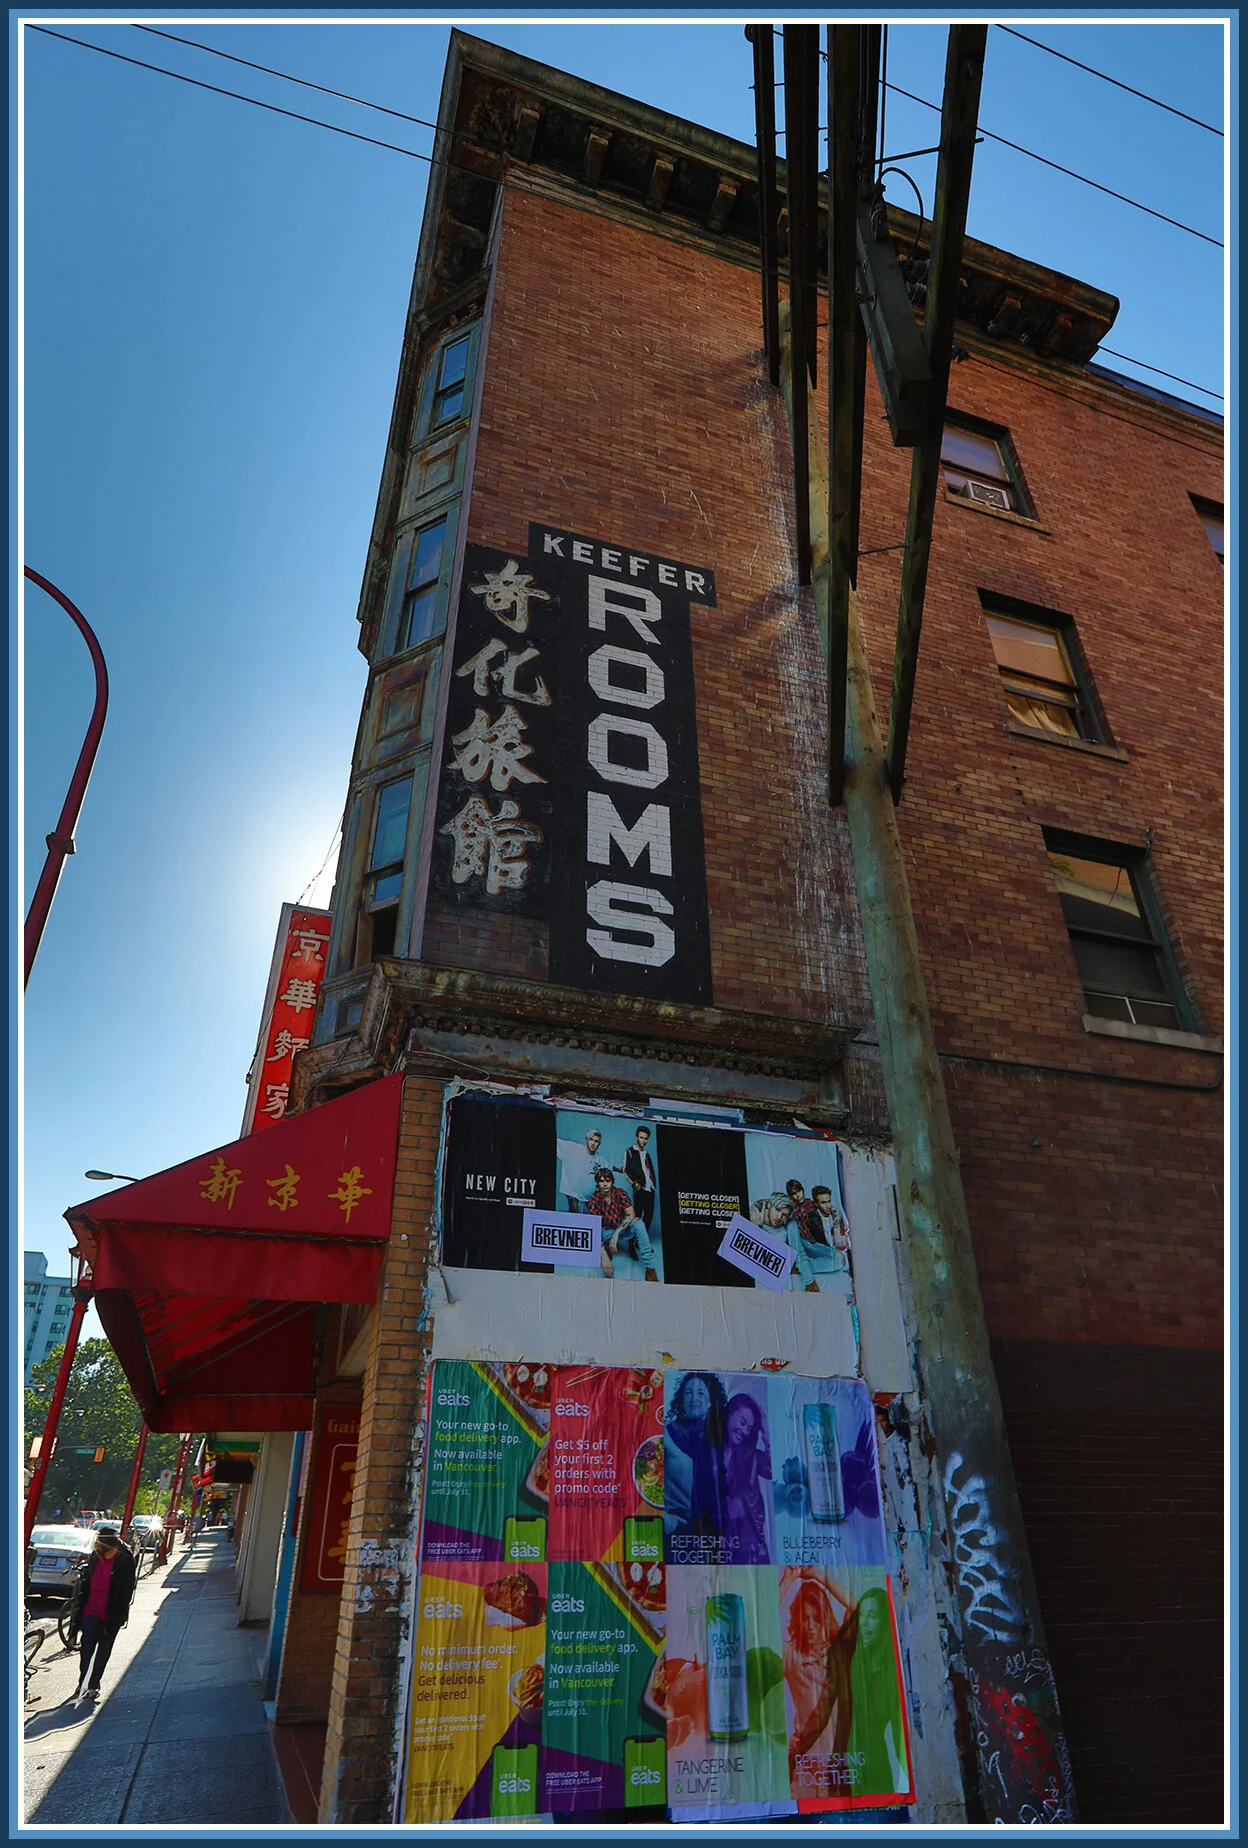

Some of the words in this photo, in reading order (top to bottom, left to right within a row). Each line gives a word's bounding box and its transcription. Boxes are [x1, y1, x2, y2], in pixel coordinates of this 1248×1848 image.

[544, 533, 705, 595] KEEFER
[439, 559, 551, 896] 奇化旅館
[586, 574, 676, 968] ROOMS
[466, 1173, 496, 1192] NEW
[504, 1177, 536, 1195] CITY
[535, 1226, 590, 1249] BREVNER
[734, 1233, 782, 1274] BREVNER
[437, 1393, 470, 1406] eats
[555, 1402, 590, 1417] eats
[436, 1420, 459, 1430] Your
[461, 1422, 482, 1430] new
[483, 1422, 509, 1432] go-to
[435, 1432, 457, 1441] food
[460, 1432, 498, 1444] delivery
[501, 1434, 522, 1445] app.
[555, 1440, 575, 1450] Get
[576, 1440, 590, 1452] $5
[592, 1439, 608, 1450] off
[813, 1446, 832, 1457] BAY
[434, 1450, 457, 1459] Now
[458, 1450, 502, 1460] available
[555, 1455, 580, 1466] your
[582, 1454, 604, 1464] first
[607, 1455, 613, 1465] 2
[433, 1461, 442, 1471] in
[555, 1468, 590, 1479] orders
[592, 1468, 616, 1479] with
[554, 1484, 589, 1495] promo
[671, 1535, 740, 1549] REFRESHING
[784, 1537, 842, 1549] BLUEBERRY
[510, 1544, 540, 1557] eats
[631, 1544, 658, 1557] eats
[671, 1550, 733, 1563] TOGETHER
[784, 1552, 792, 1563] &
[795, 1551, 820, 1563] ACAI
[423, 1602, 463, 1619] eats
[551, 1597, 585, 1612] eats
[551, 1630, 574, 1640] Your
[576, 1631, 597, 1639] new
[599, 1629, 625, 1642] go-to
[712, 1634, 741, 1647] PALM
[421, 1646, 436, 1657] No
[488, 1644, 518, 1655] order.
[550, 1645, 573, 1654] food
[575, 1643, 616, 1656] delivery
[618, 1644, 638, 1655] app.
[715, 1647, 738, 1660] BAY
[420, 1661, 434, 1671] No
[437, 1658, 479, 1672] delivery
[550, 1664, 572, 1674] Now
[575, 1662, 620, 1673] available
[418, 1675, 436, 1686] Get
[440, 1673, 485, 1685] delicious
[549, 1678, 559, 1688] in
[417, 1688, 470, 1702] delivered.
[675, 1757, 744, 1775] TANGERINE
[794, 1751, 866, 1769] REFRESHING
[546, 1771, 579, 1779] DOWNLOAD
[630, 1768, 661, 1786] eats
[796, 1769, 860, 1787] TOGETHER
[498, 1777, 530, 1794] eats
[675, 1779, 684, 1794] &
[687, 1777, 719, 1794] LIME
